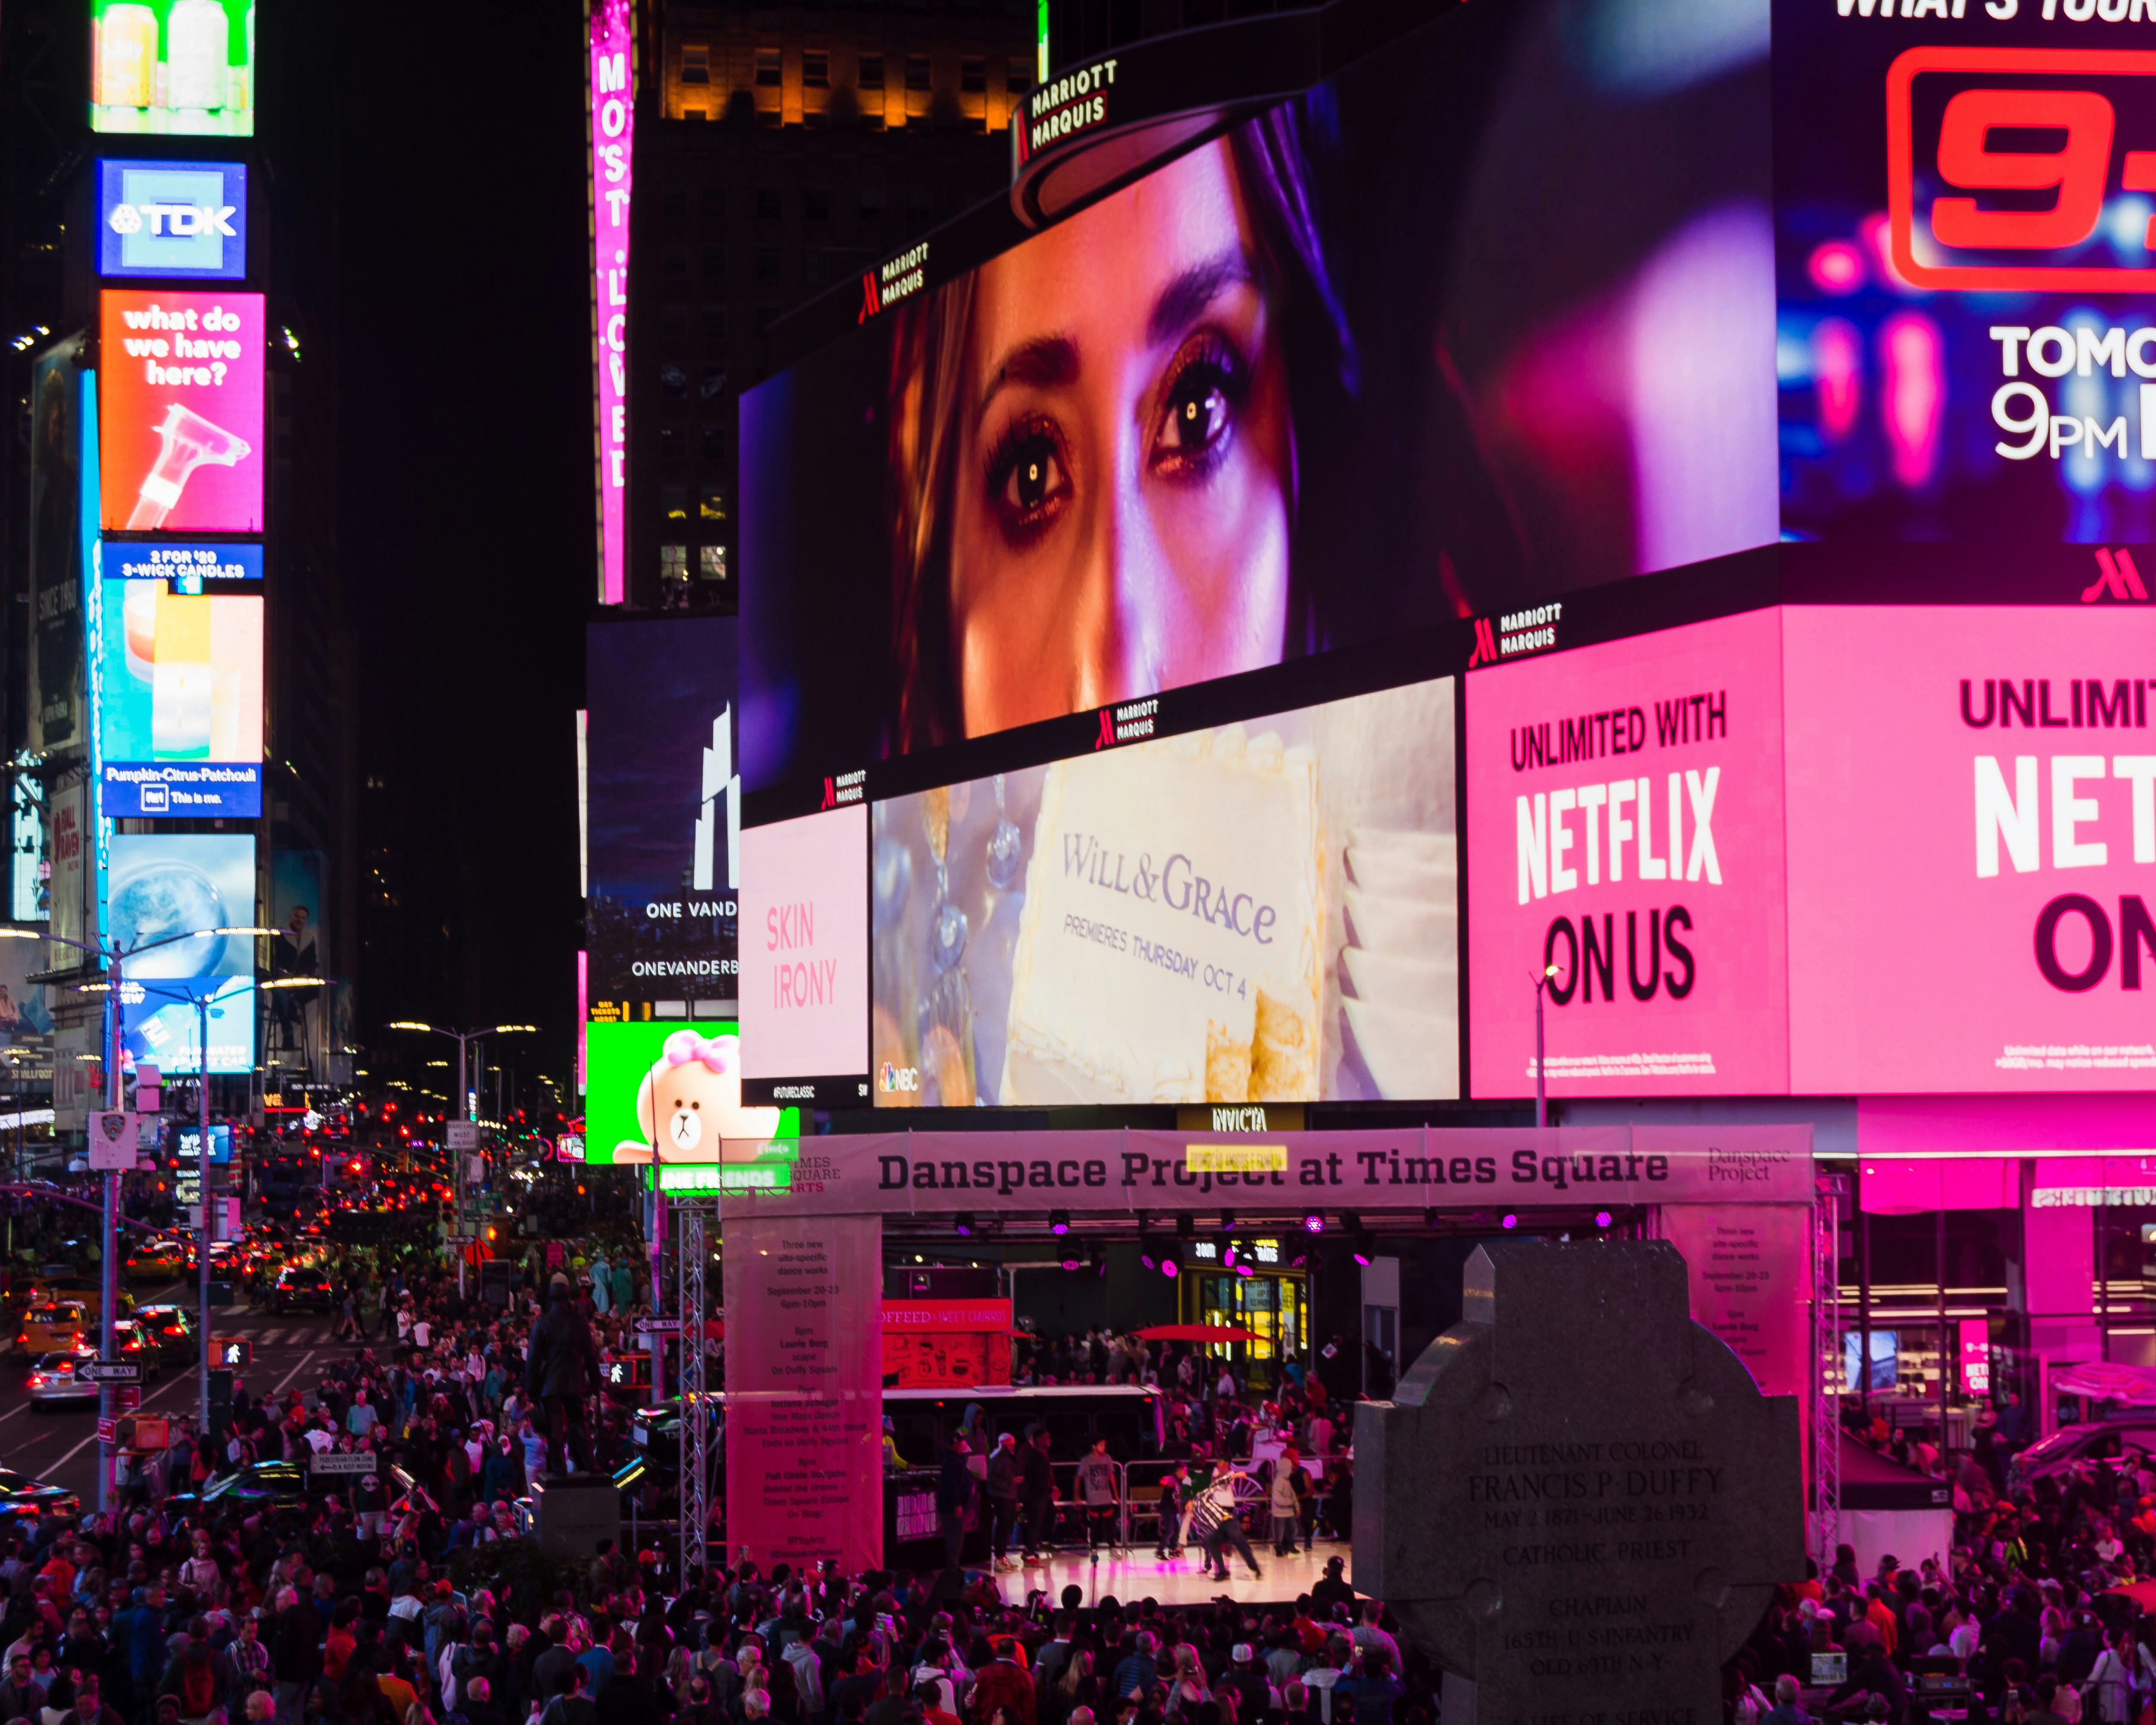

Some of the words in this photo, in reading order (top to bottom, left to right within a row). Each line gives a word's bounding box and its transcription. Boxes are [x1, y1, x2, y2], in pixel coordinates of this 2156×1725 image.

[1032, 60, 1117, 118] MARRIOTT
[1032, 96, 1105, 150] MARQUIS
[599, 53, 625, 227] MOST
[140, 205, 237, 236] TDK
[882, 242, 928, 282] MARRIOTT
[882, 269, 923, 305] MARQUIS
[123, 304, 198, 331] what
[202, 306, 241, 332] do
[123, 339, 169, 358] we
[175, 332, 241, 359] have
[147, 359, 227, 386] here?
[1991, 381, 2128, 460] 9PM
[150, 550, 161, 564] 2
[162, 550, 193, 564] FOR
[122, 563, 175, 577] 3-WICK
[177, 564, 245, 578] CANDLES
[1501, 603, 1562, 633] MARRIOTT
[1501, 627, 1555, 655] MARQUIS
[1117, 699, 1159, 722] MARRIOTT
[1117, 719, 1154, 740] MARQUIS
[1510, 706, 1646, 771] UNLIMITED
[1655, 690, 1727, 747] WITH
[836, 770, 866, 788] MARRIOTT
[836, 786, 863, 803] MARQUIS
[1517, 766, 1723, 906] NETFLIX
[646, 902, 682, 918] ONE
[688, 901, 738, 917] VAND
[767, 901, 814, 951] SKIN
[1063, 914, 1127, 952] PREMIERES
[1133, 936, 1199, 982] THURSDAY
[1203, 963, 1234, 995] OCT
[1237, 978, 1247, 1001] 4
[1544, 912, 1614, 1007] ON
[1627, 904, 1695, 1002] US
[774, 958, 837, 1009] IRONY
[895, 1067, 918, 1092] NBC
[774, 1085, 815, 1100] #FUTURECLASSIC
[1212, 1107, 1267, 1132] INVICTA
[787, 1157, 830, 1169] TIMES
[1708, 1146, 1791, 1168] Danspace
[695, 1171, 775, 1189] FRENDS
[787, 1168, 841, 1182] SQUARE
[877, 1155, 1106, 1195] Danspace
[1121, 1152, 1285, 1193] Project
[1299, 1152, 1343, 1186] at
[1357, 1148, 1496, 1186] Times
[1511, 1150, 1669, 1189] Square
[1708, 1163, 1770, 1184] Project
[788, 1182, 824, 1193] ARTS
[782, 1239, 804, 1250] Three
[806, 1241, 824, 1249] new
[777, 1252, 827, 1263] site-specific
[777, 1267, 802, 1276] dance
[805, 1265, 828, 1275] works
[767, 1286, 812, 1297] September
[639, 1320, 653, 1329] ONE
[661, 1320, 677, 1329] WAY
[938, 1310, 965, 1323] SWEET
[968, 1310, 1007, 1323] CHURROS
[779, 1339, 806, 1349] Laurie
[808, 1338, 829, 1350] Berg
[85, 1367, 104, 1376] ONE
[112, 1366, 132, 1376] WAY
[808, 1364, 838, 1376] Square
[1484, 1443, 1603, 1466] LIEUTENANT
[1608, 1440, 1705, 1462] COLONEL
[1467, 1471, 1589, 1502] FRANCIS
[1625, 1467, 1724, 1496] DUFFY
[1483, 1509, 1523, 1529] MAY
[1502, 1542, 1607, 1566] CATHOLIC
[1617, 1539, 1692, 1560] PRIEST
[1548, 1596, 1648, 1617] CHAPLAIN
[1504, 1630, 1558, 1650] 165TH
[1530, 1658, 1571, 1676] OLD
[1576, 1656, 1622, 1674] 69TH
